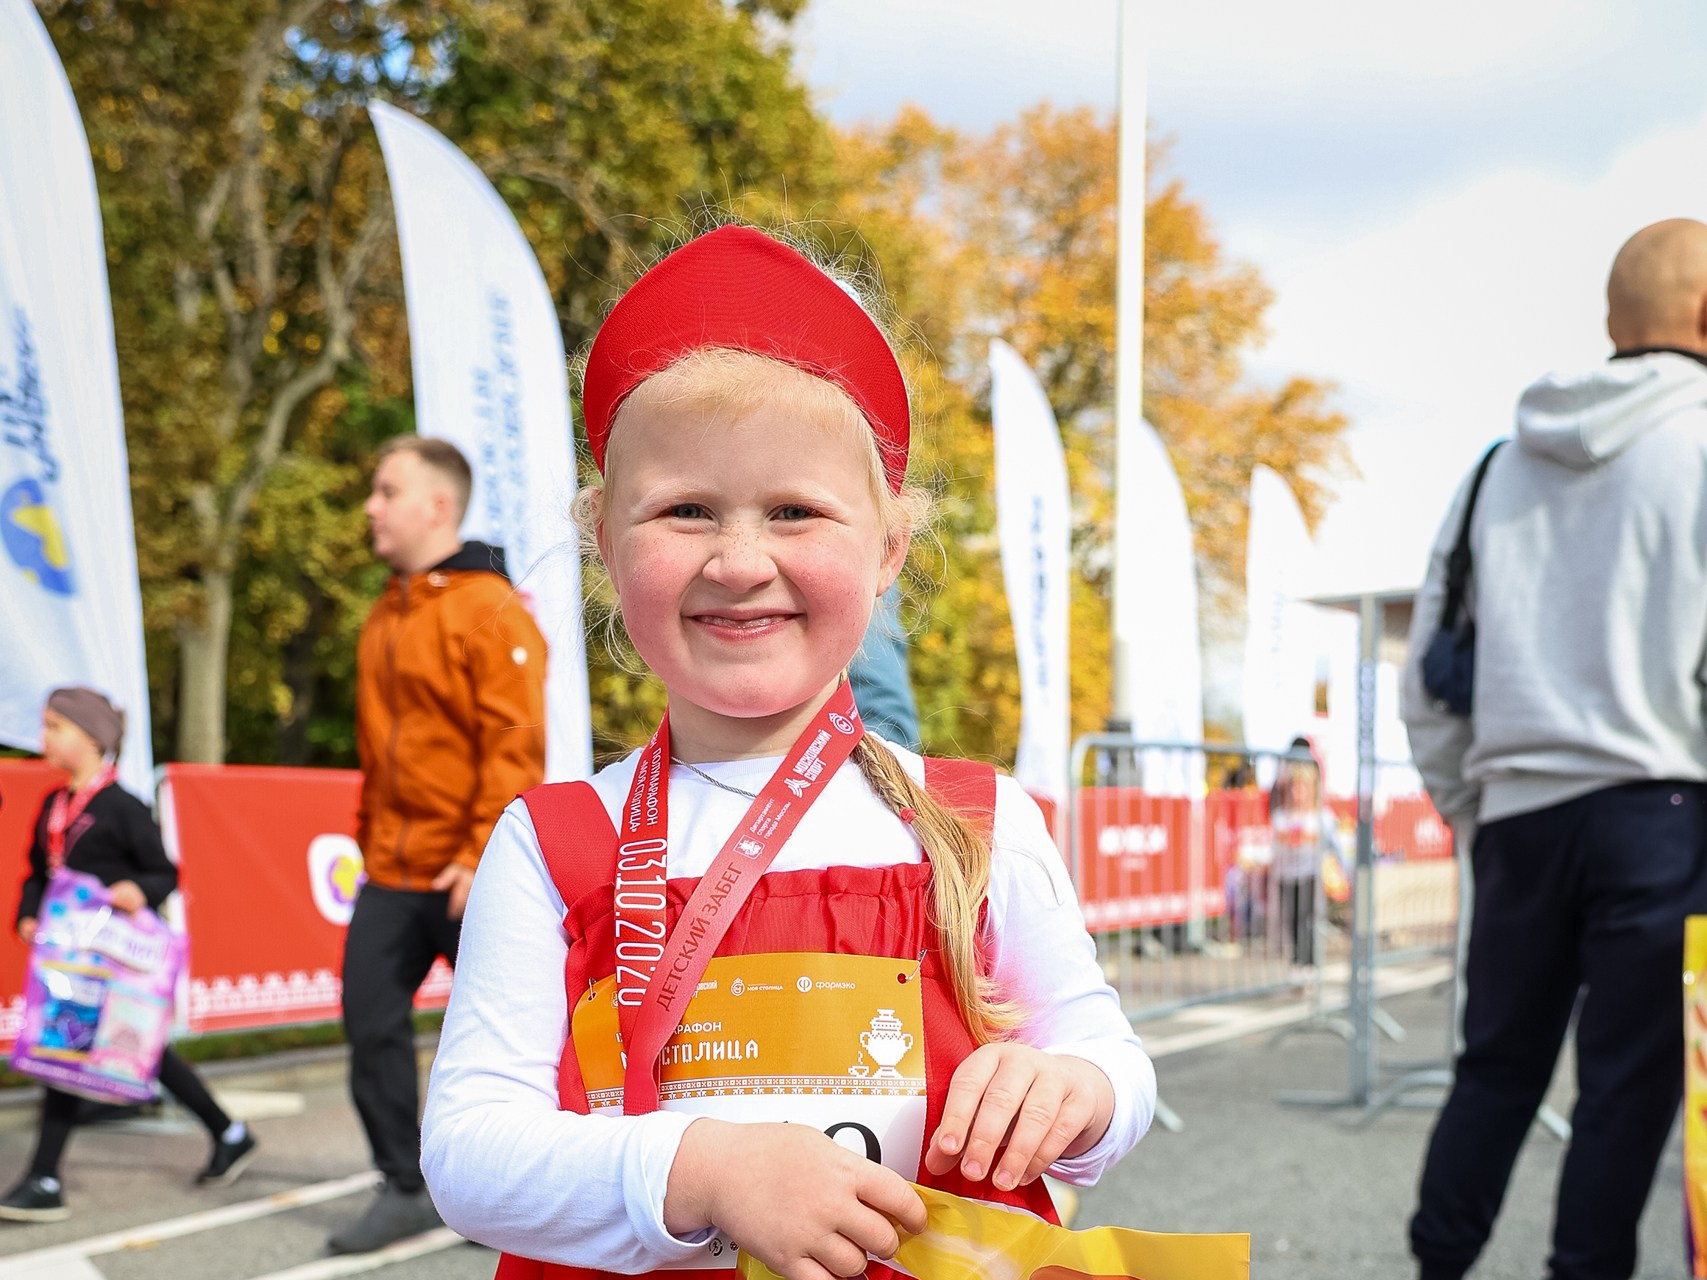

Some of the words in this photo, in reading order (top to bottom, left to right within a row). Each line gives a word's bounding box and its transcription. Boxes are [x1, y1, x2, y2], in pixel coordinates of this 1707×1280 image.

[793, 729, 832, 775] МОСКОВСКИЙ
[803, 757, 827, 782] СПОРТ
[646, 747, 662, 826] ПОЛУМАРАФОН
[656, 917, 711, 1012] ДЕТСКИЙ
[702, 862, 742, 916] ЗАБЕГ
